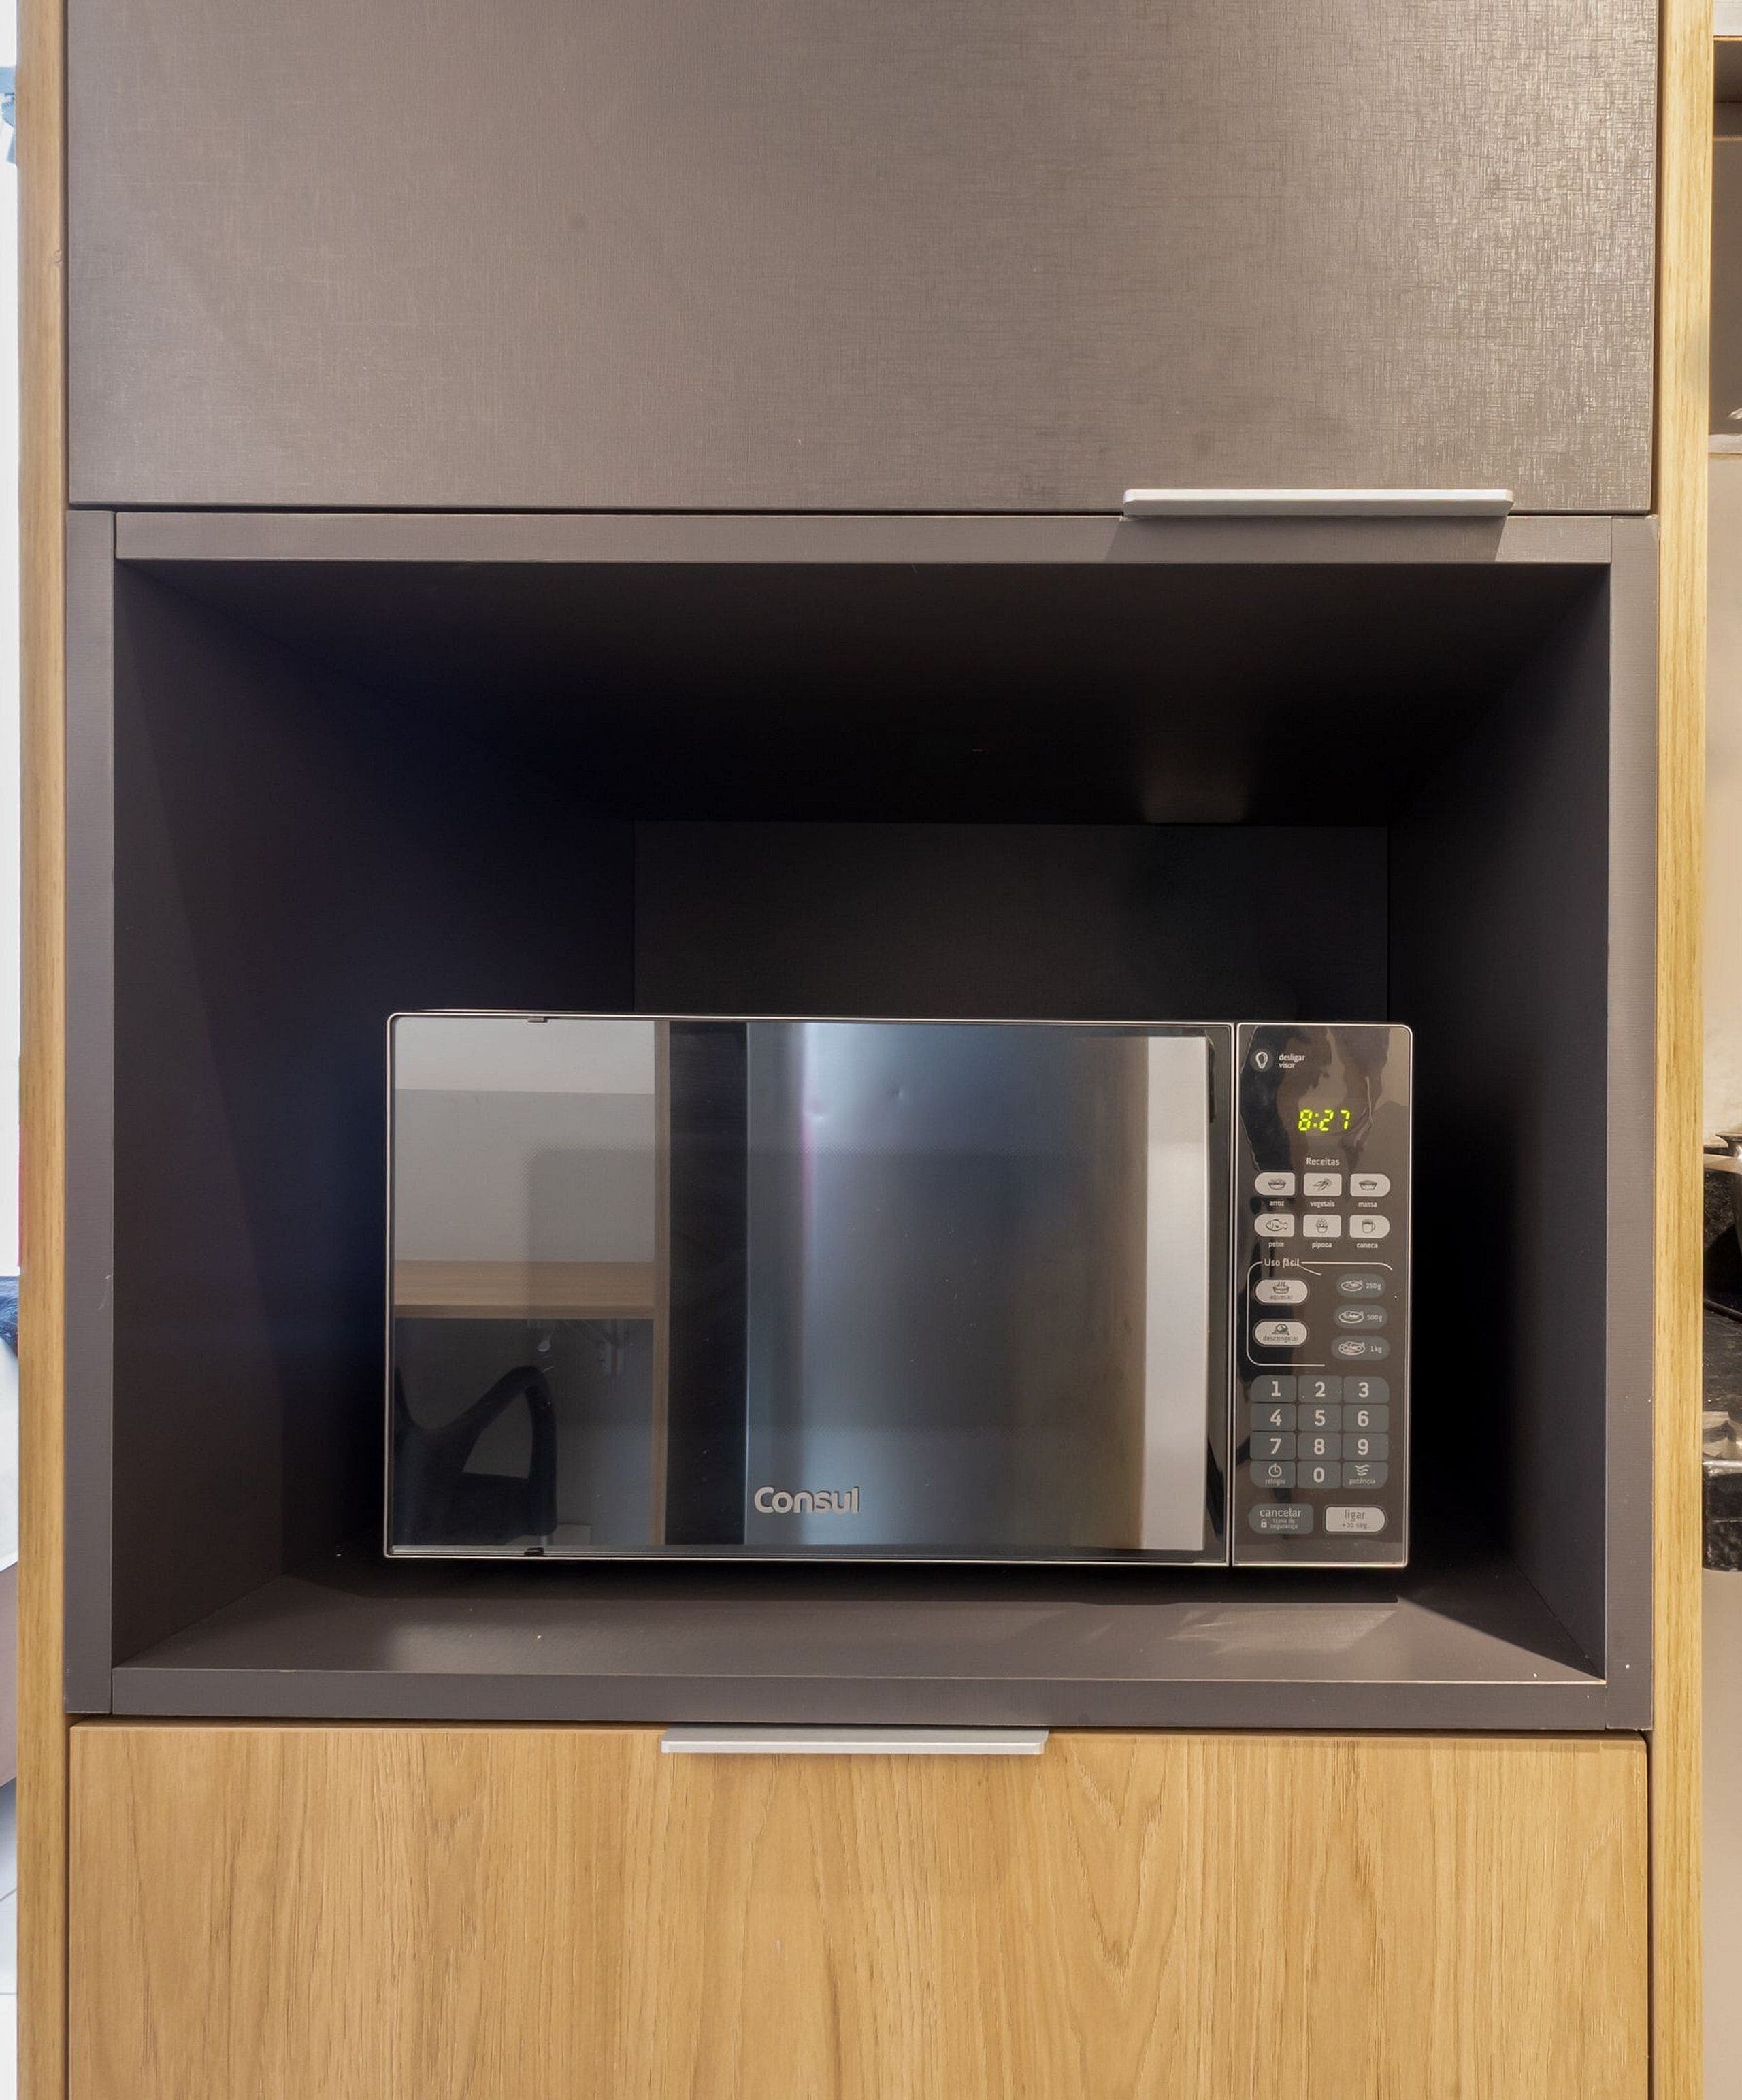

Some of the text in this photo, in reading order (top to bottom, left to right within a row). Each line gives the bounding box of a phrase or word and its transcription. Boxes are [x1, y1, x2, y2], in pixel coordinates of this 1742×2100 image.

[1279, 1053, 1305, 1062] desligar
[1298, 1109, 1351, 1132] 8:27
[1306, 1158, 1340, 1166] Receitas
[1310, 1200, 1335, 1208] vegetais
[1271, 1381, 1281, 1396] 1
[1315, 1381, 1325, 1397] 2
[1358, 1382, 1369, 1398] 3
[1270, 1409, 1282, 1426] 4
[1314, 1410, 1325, 1426] 5
[1357, 1411, 1369, 1427] 6
[1270, 1438, 1281, 1455] 7
[1314, 1439, 1325, 1455] 8
[1357, 1439, 1369, 1455] 9
[1313, 1467, 1325, 1483] 0
[754, 1486, 860, 1514] Consul
[1260, 1507, 1302, 1517] cancelar
[1344, 1509, 1366, 1522] ligar
